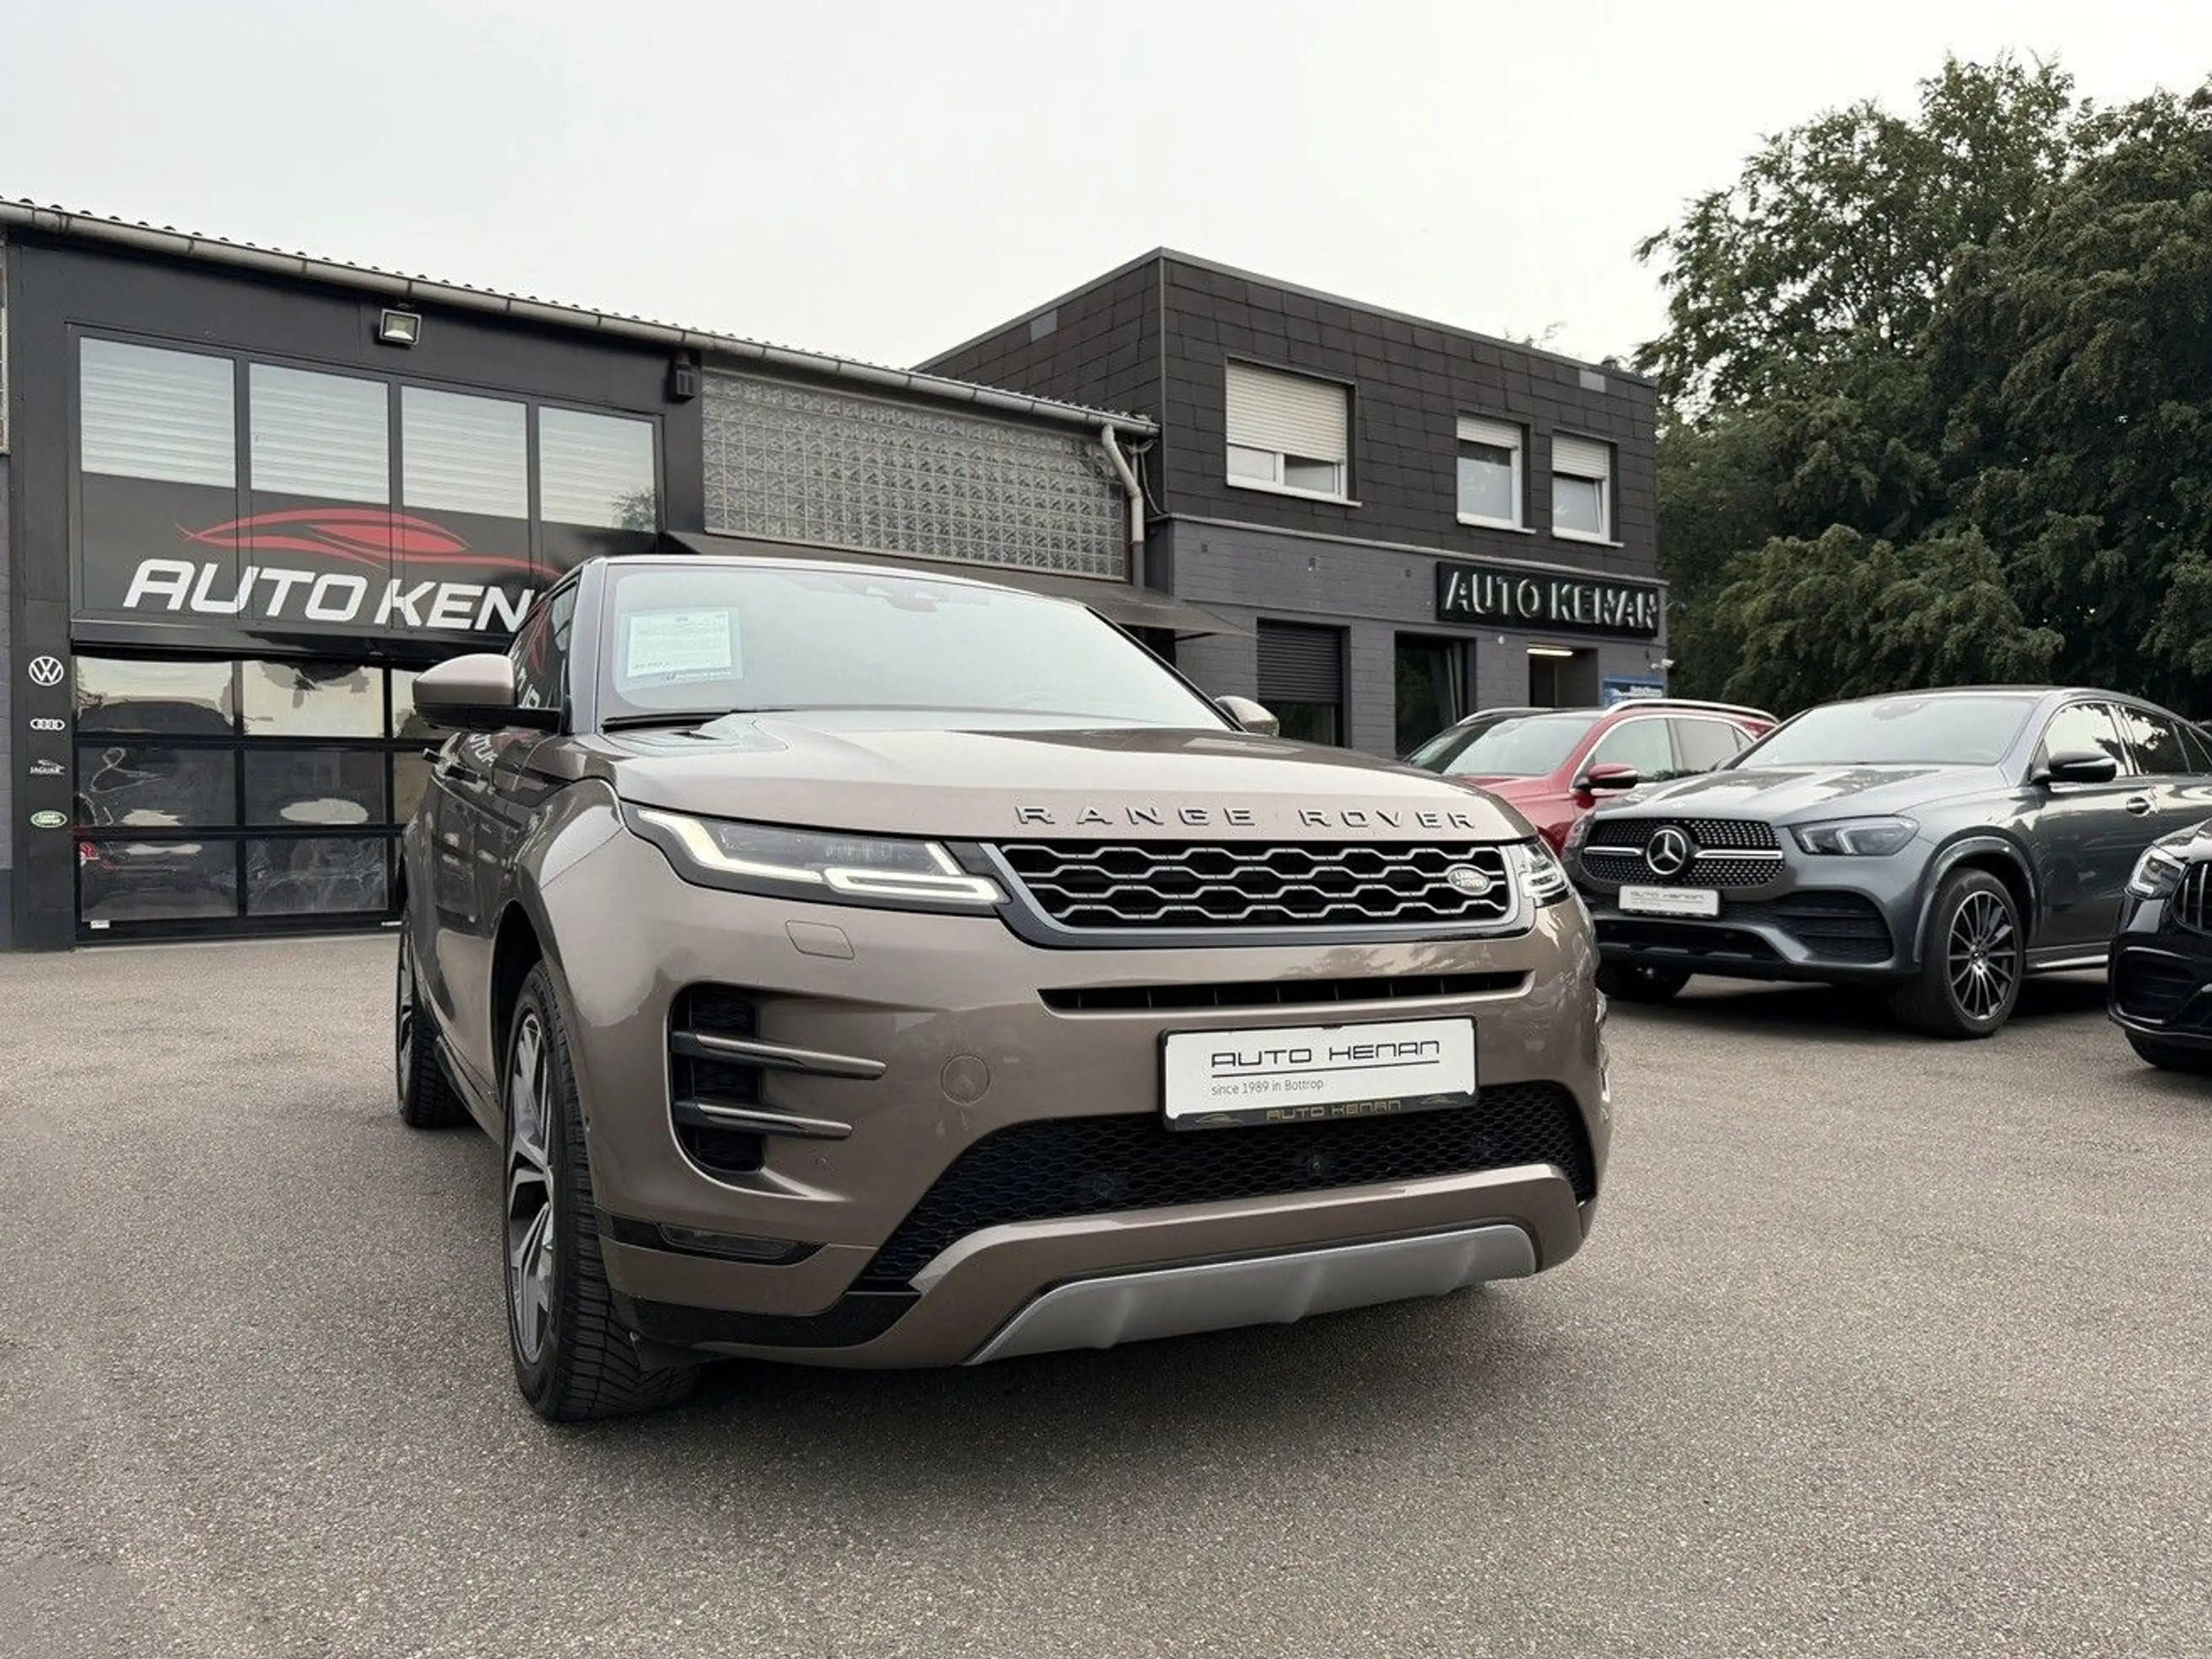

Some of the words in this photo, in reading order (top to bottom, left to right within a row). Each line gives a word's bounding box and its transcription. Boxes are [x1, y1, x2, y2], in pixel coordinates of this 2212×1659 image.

[122, 558, 369, 622] AUTO
[374, 578, 547, 633] KEN
[1445, 571, 1540, 618] AUTO
[1551, 582, 1658, 630] KENAN
[1015, 806, 1256, 826] RANGE
[1298, 809, 1476, 830] ROVER
[1211, 1048, 1312, 1067] AUTO
[1211, 1082, 1239, 1095] since
[1242, 1080, 1269, 1094] 1989
[1272, 1079, 1281, 1092] in
[1285, 1078, 1324, 1092] Bottrop
[1266, 1106, 1325, 1121] AUTO
